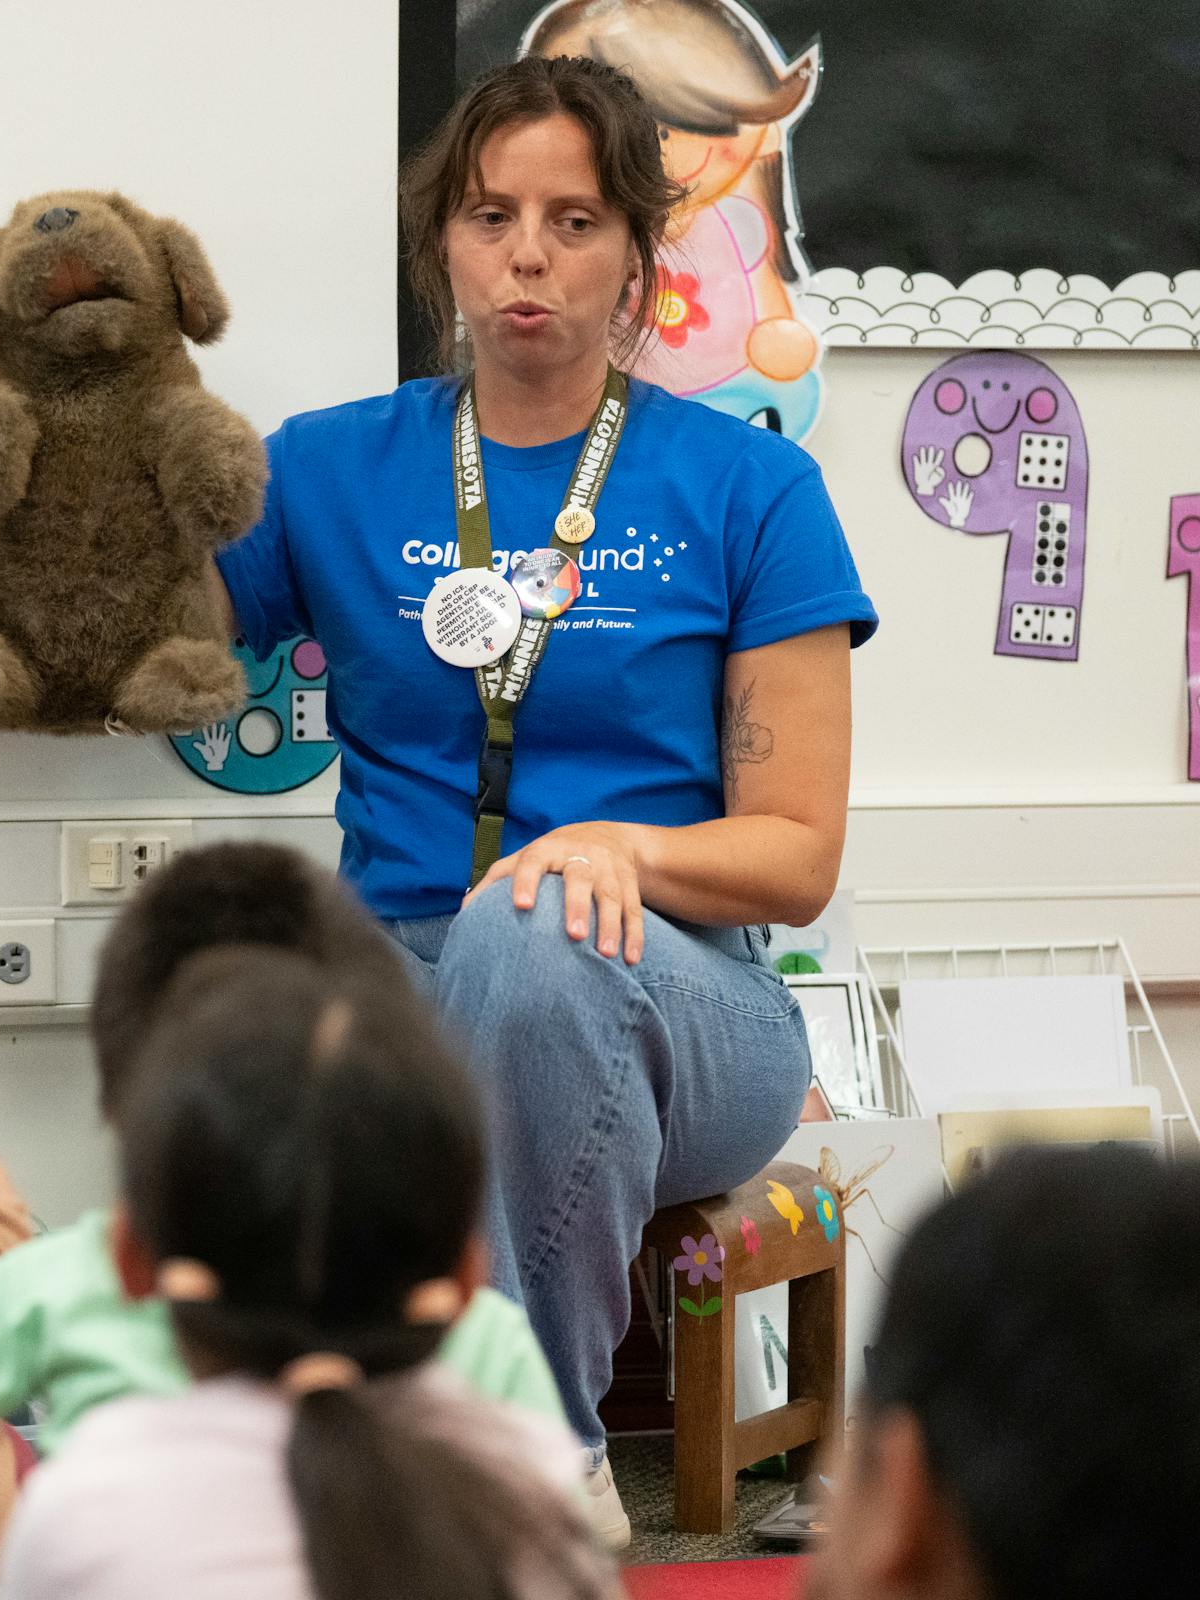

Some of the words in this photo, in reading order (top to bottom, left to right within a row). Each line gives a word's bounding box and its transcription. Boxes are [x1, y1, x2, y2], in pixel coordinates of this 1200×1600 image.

[461, 389, 482, 511] MINNESOTA
[568, 398, 621, 511] MINNESOTA
[564, 511, 581, 528] SHE
[570, 521, 586, 537] HER
[436, 605, 463, 626] AGENTS
[479, 585, 490, 595] BE
[437, 603, 453, 615] DHS
[453, 596, 463, 604] OR
[464, 584, 479, 596] CBP
[441, 594, 452, 603] NO
[453, 584, 467, 595] ICE,
[436, 607, 475, 635] PERMITTED
[475, 589, 497, 607] ERY
[572, 619, 593, 629] and
[596, 619, 635, 629] Future.
[436, 620, 468, 644] WITHOUT
[445, 621, 479, 647] WARRANT
[459, 637, 470, 647] BY
